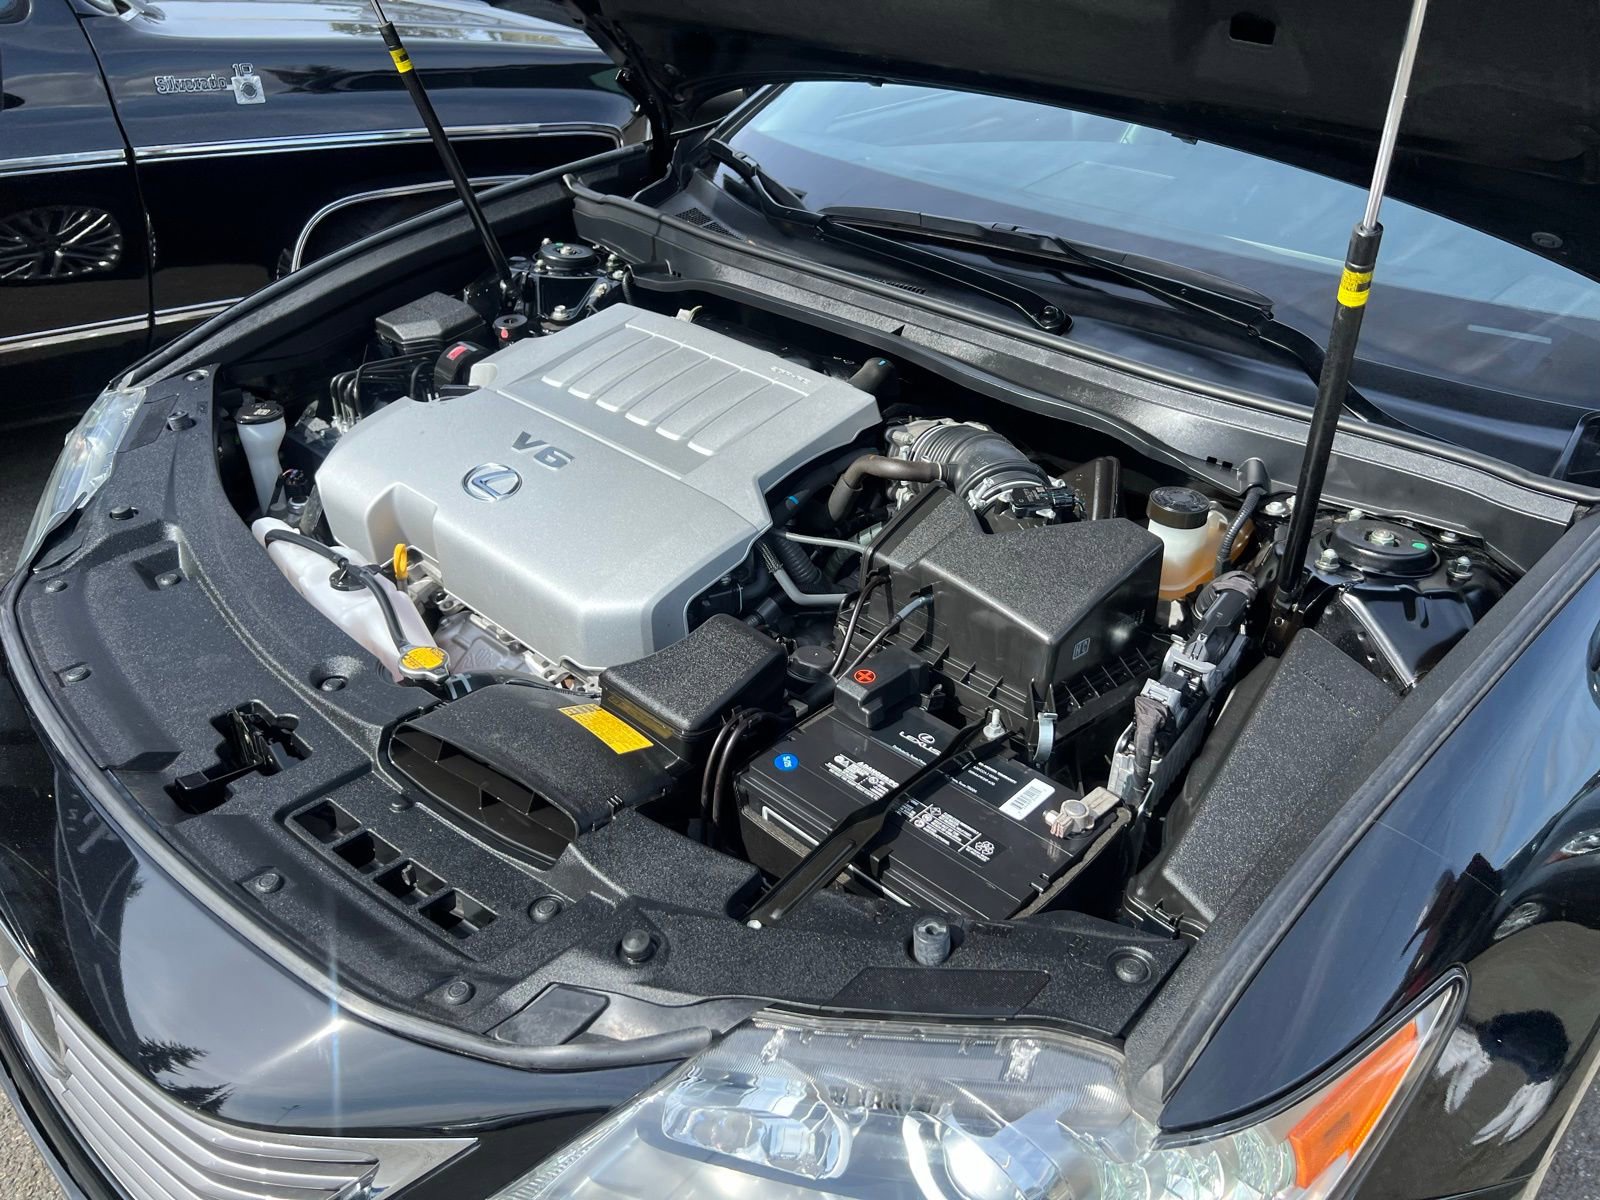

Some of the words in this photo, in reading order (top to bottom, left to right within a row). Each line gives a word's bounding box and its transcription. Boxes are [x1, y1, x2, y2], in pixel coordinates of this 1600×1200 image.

[232, 63, 253, 76] 10
[155, 74, 228, 95] Silverado
[511, 431, 576, 470] V6
[899, 731, 942, 756] LEXUS
